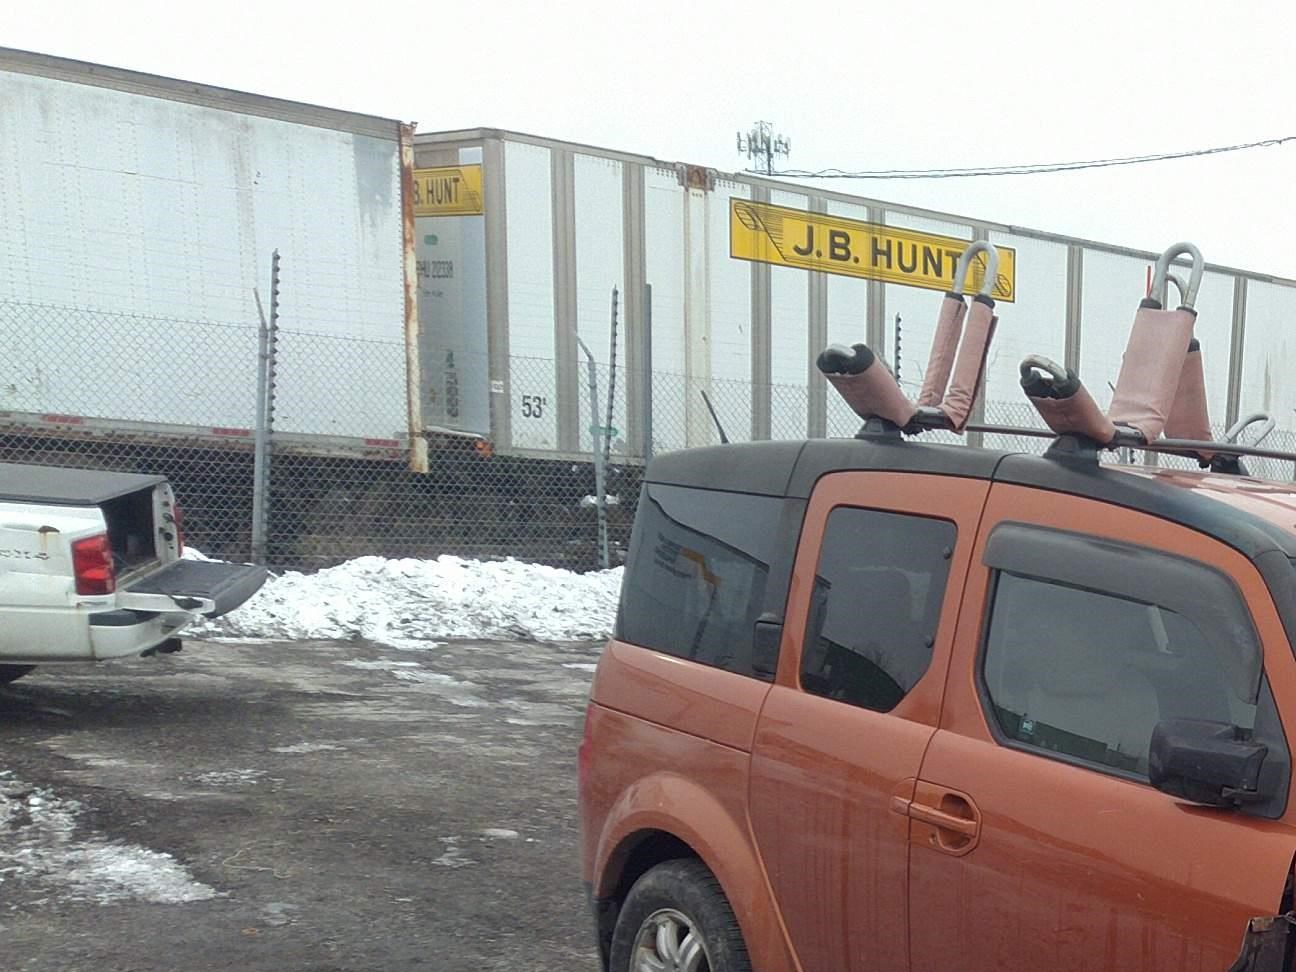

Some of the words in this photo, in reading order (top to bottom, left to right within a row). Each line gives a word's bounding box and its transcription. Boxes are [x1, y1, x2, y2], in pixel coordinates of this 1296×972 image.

[426, 177, 460, 205] HUNT
[793, 225, 860, 264] J.B.
[871, 236, 962, 280] HUNT
[521, 395, 547, 418] 53'
